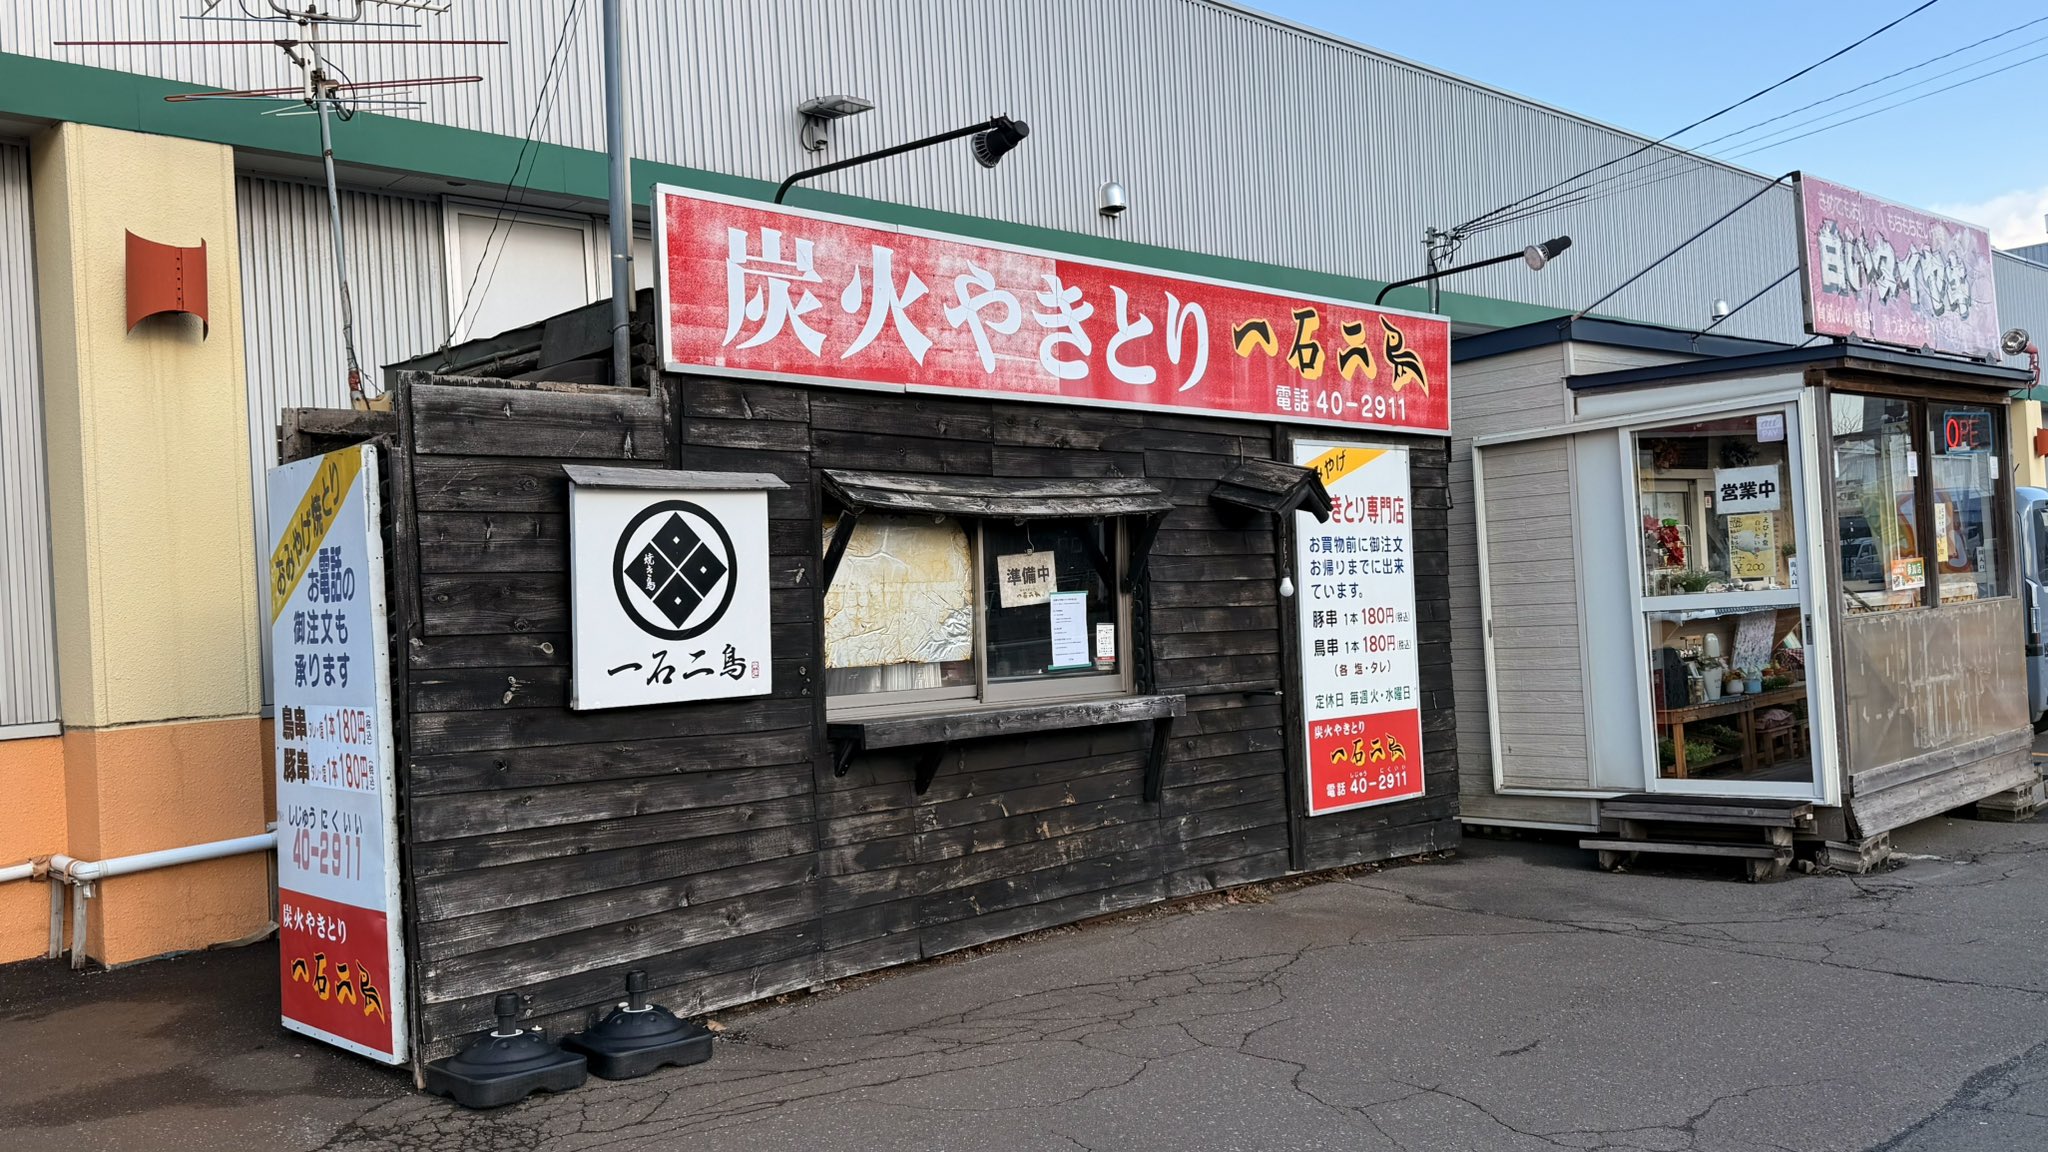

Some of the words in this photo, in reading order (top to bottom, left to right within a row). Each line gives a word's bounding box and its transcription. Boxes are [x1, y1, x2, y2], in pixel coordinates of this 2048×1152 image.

[723, 226, 1209, 392] 炭火やきとり
[1276, 385, 1310, 412] 電話
[1315, 389, 1407, 421] 40-2911
[1762, 430, 1779, 438] PAY
[1720, 480, 1776, 502] 営業中
[1309, 535, 1404, 555] お買物前に御注文
[306, 545, 355, 604] お電話の
[1007, 564, 1051, 587] 準備中
[1309, 557, 1405, 577] お帰りまでに出来
[1310, 582, 1363, 600] ています。
[293, 608, 349, 646] 御注文も
[1312, 609, 1338, 629] 豚串
[1313, 638, 1339, 657] 鳥串
[294, 651, 350, 689] 承ります
[607, 643, 748, 687] 一石二鳥
[1315, 691, 1345, 711] 定休日
[1350, 684, 1411, 707] 毎週火・水曜日
[1314, 719, 1366, 741] 炭火やきとり
[1326, 782, 1347, 798] 電話
[1350, 770, 1408, 795] 40-2911
[287, 804, 317, 830] しじゅう
[320, 808, 364, 835] にくいい
[293, 828, 362, 882] 40-2911
[282, 903, 348, 945] 炭火やきとり
